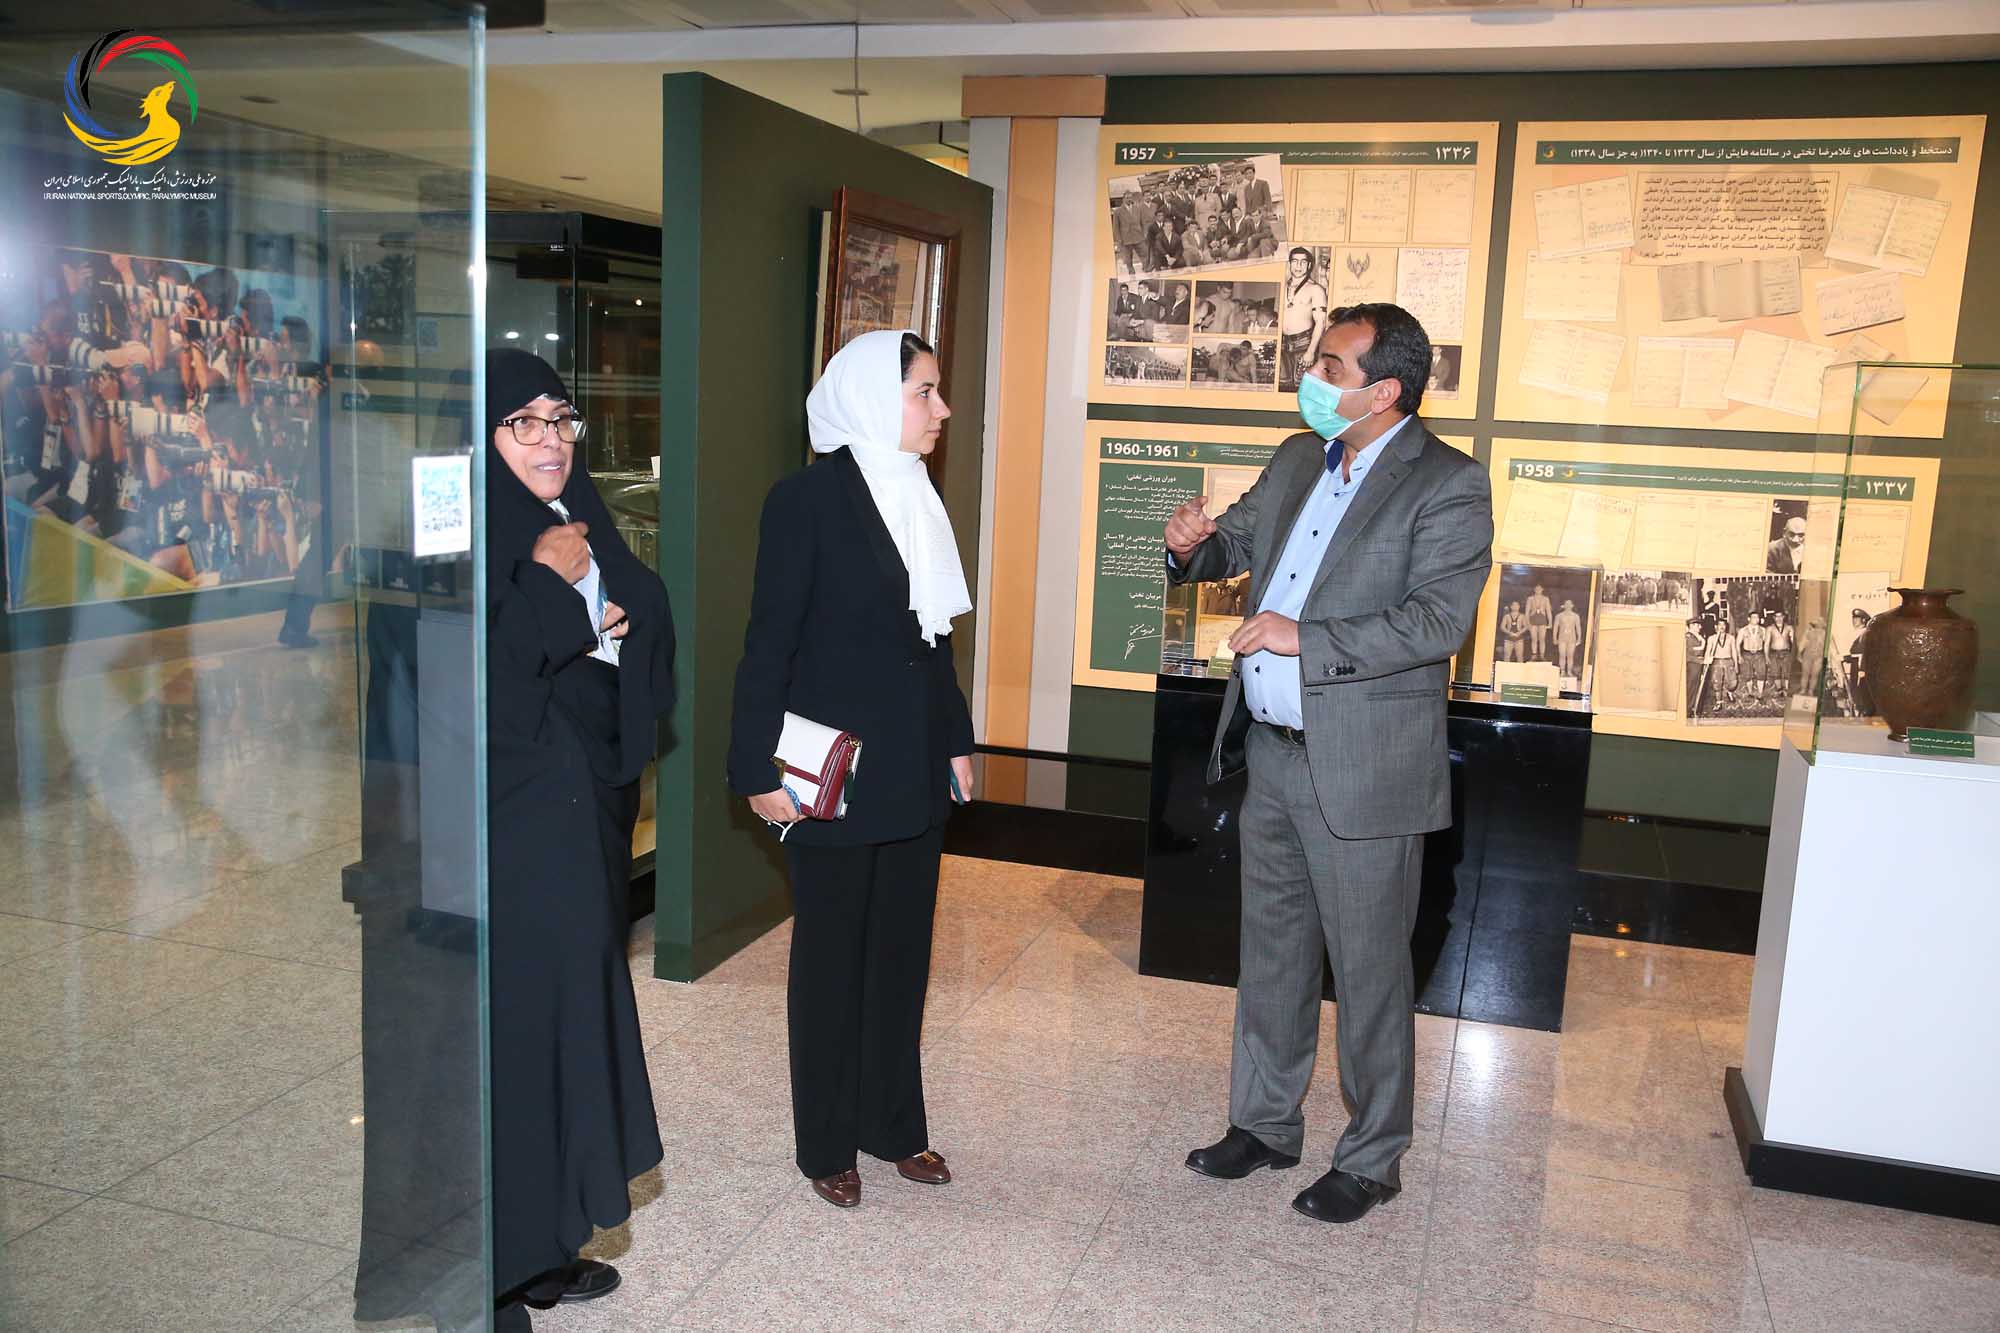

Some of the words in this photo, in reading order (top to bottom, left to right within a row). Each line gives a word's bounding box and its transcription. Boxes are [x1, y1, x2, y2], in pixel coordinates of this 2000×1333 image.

[1121, 147, 1157, 160] 1957
[1436, 146, 1472, 161] ۱۳۳۶
[1598, 148, 1616, 159] سال
[1665, 148, 1671, 158] تا
[1697, 149, 1715, 159] سال
[1781, 149, 1791, 159] در
[1792, 148, 1817, 160] تختی
[1818, 147, 1851, 159] غلامرضا
[1872, 147, 1909, 157] یادداشت
[1911, 149, 1917, 157] و
[1919, 145, 1953, 156] دستخط
[1106, 442, 1179, 458] 1960-1961
[1516, 463, 1555, 478] 1958
[1866, 480, 1908, 496] ۱۳۳۷
